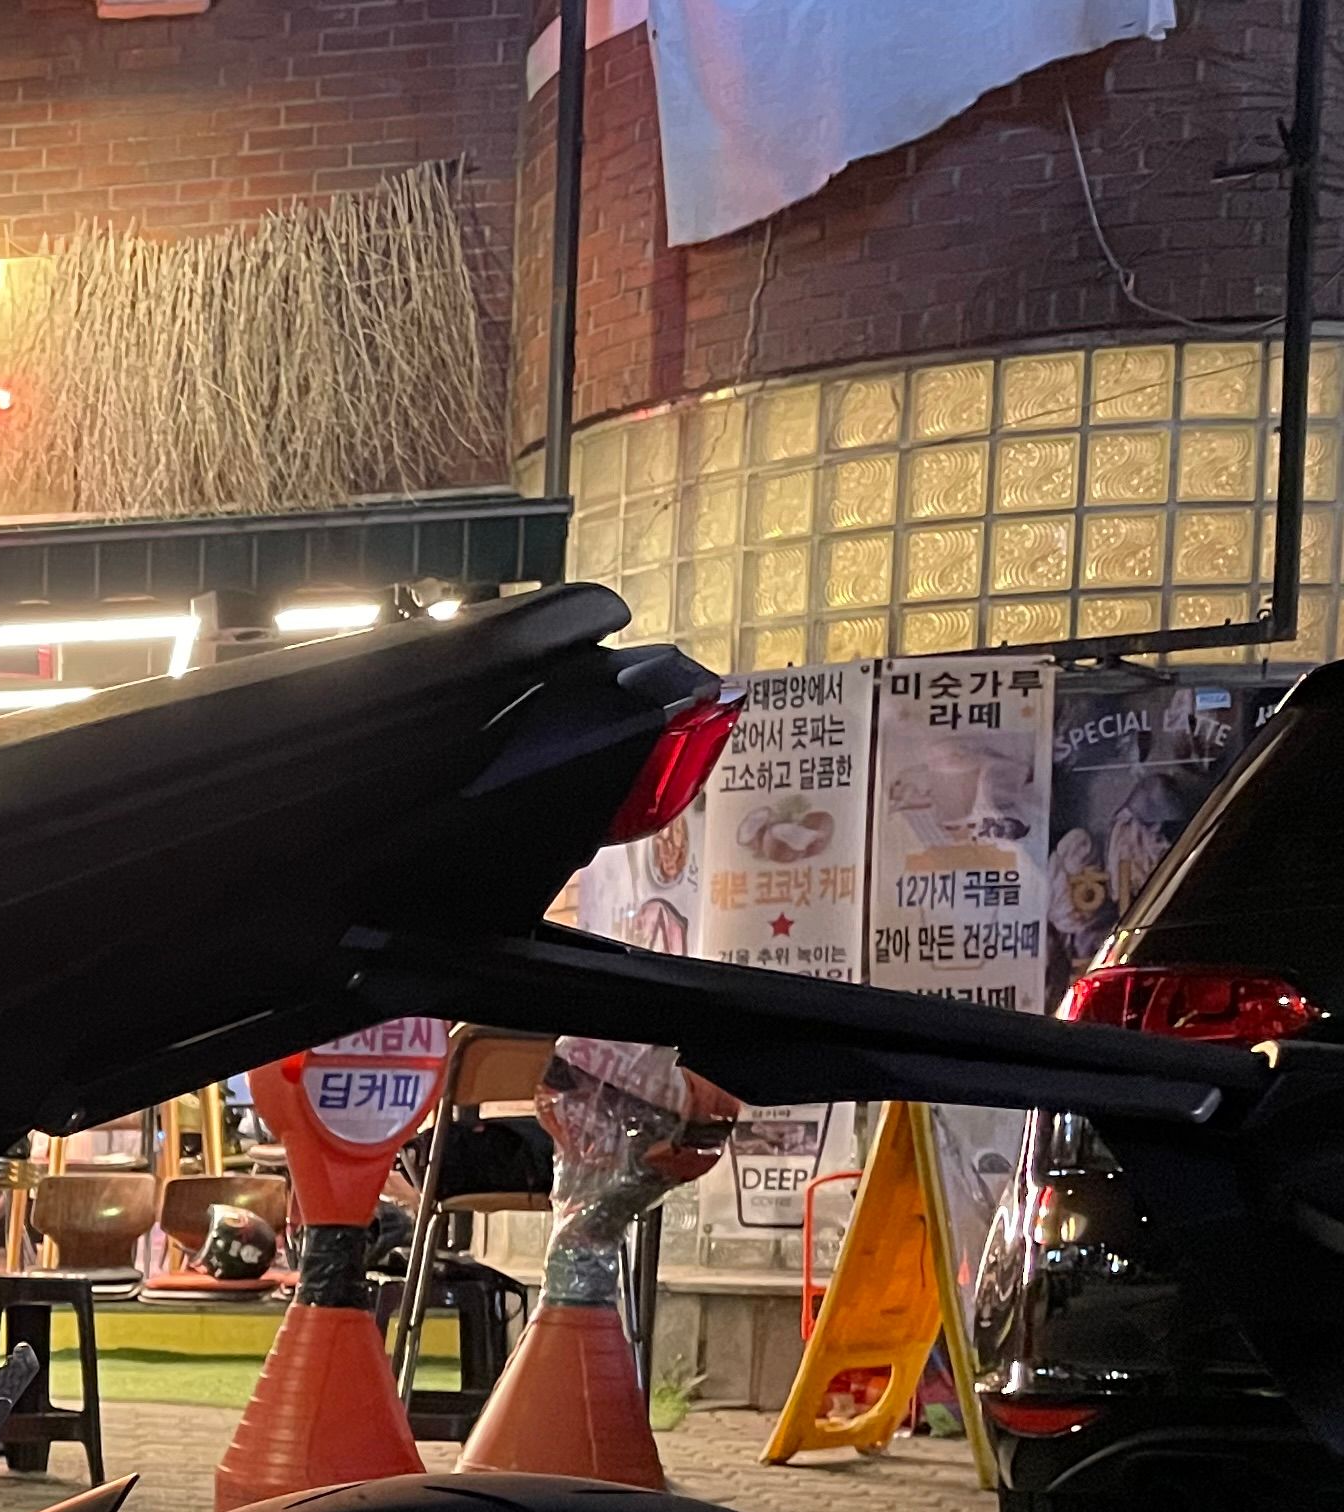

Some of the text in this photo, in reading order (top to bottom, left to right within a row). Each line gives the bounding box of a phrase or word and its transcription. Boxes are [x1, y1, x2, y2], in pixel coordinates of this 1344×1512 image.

[891, 670, 1044, 700] 미숫가루
[732, 713, 846, 754] 없어서 못파는
[929, 702, 1001, 730] 라떼
[1054, 710, 1152, 762] SPECIAL
[720, 755, 852, 793] 고소하고 달콤한
[755, 868, 812, 906] 코코넛
[819, 864, 857, 904] 커피
[896, 870, 956, 910] 12가지
[963, 870, 1021, 907] 곡물을
[875, 920, 1040, 963] 갈아 만든 건강라떼
[319, 1072, 420, 1111] 딥커피
[742, 1167, 808, 1191] DEEP
